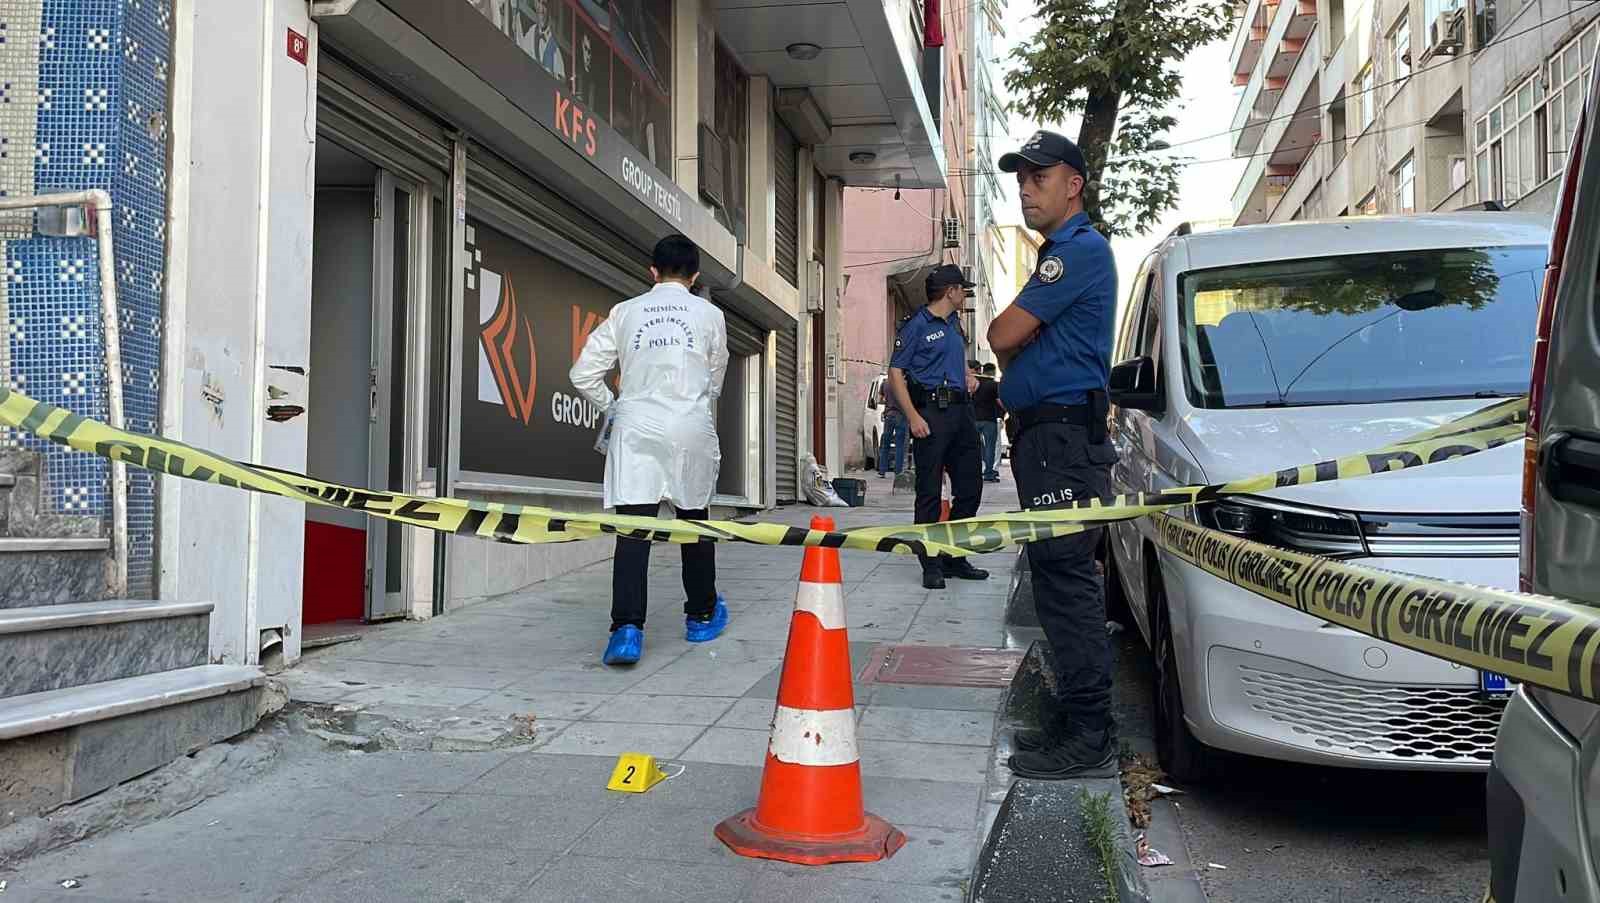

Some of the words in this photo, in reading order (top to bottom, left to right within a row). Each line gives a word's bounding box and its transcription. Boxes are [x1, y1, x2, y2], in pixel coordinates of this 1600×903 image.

[554, 90, 596, 157] KFS
[622, 157, 652, 198] GROUP
[654, 181, 681, 222] TEKSTİL
[551, 391, 599, 429] GROUP
[622, 765, 636, 784] 2
